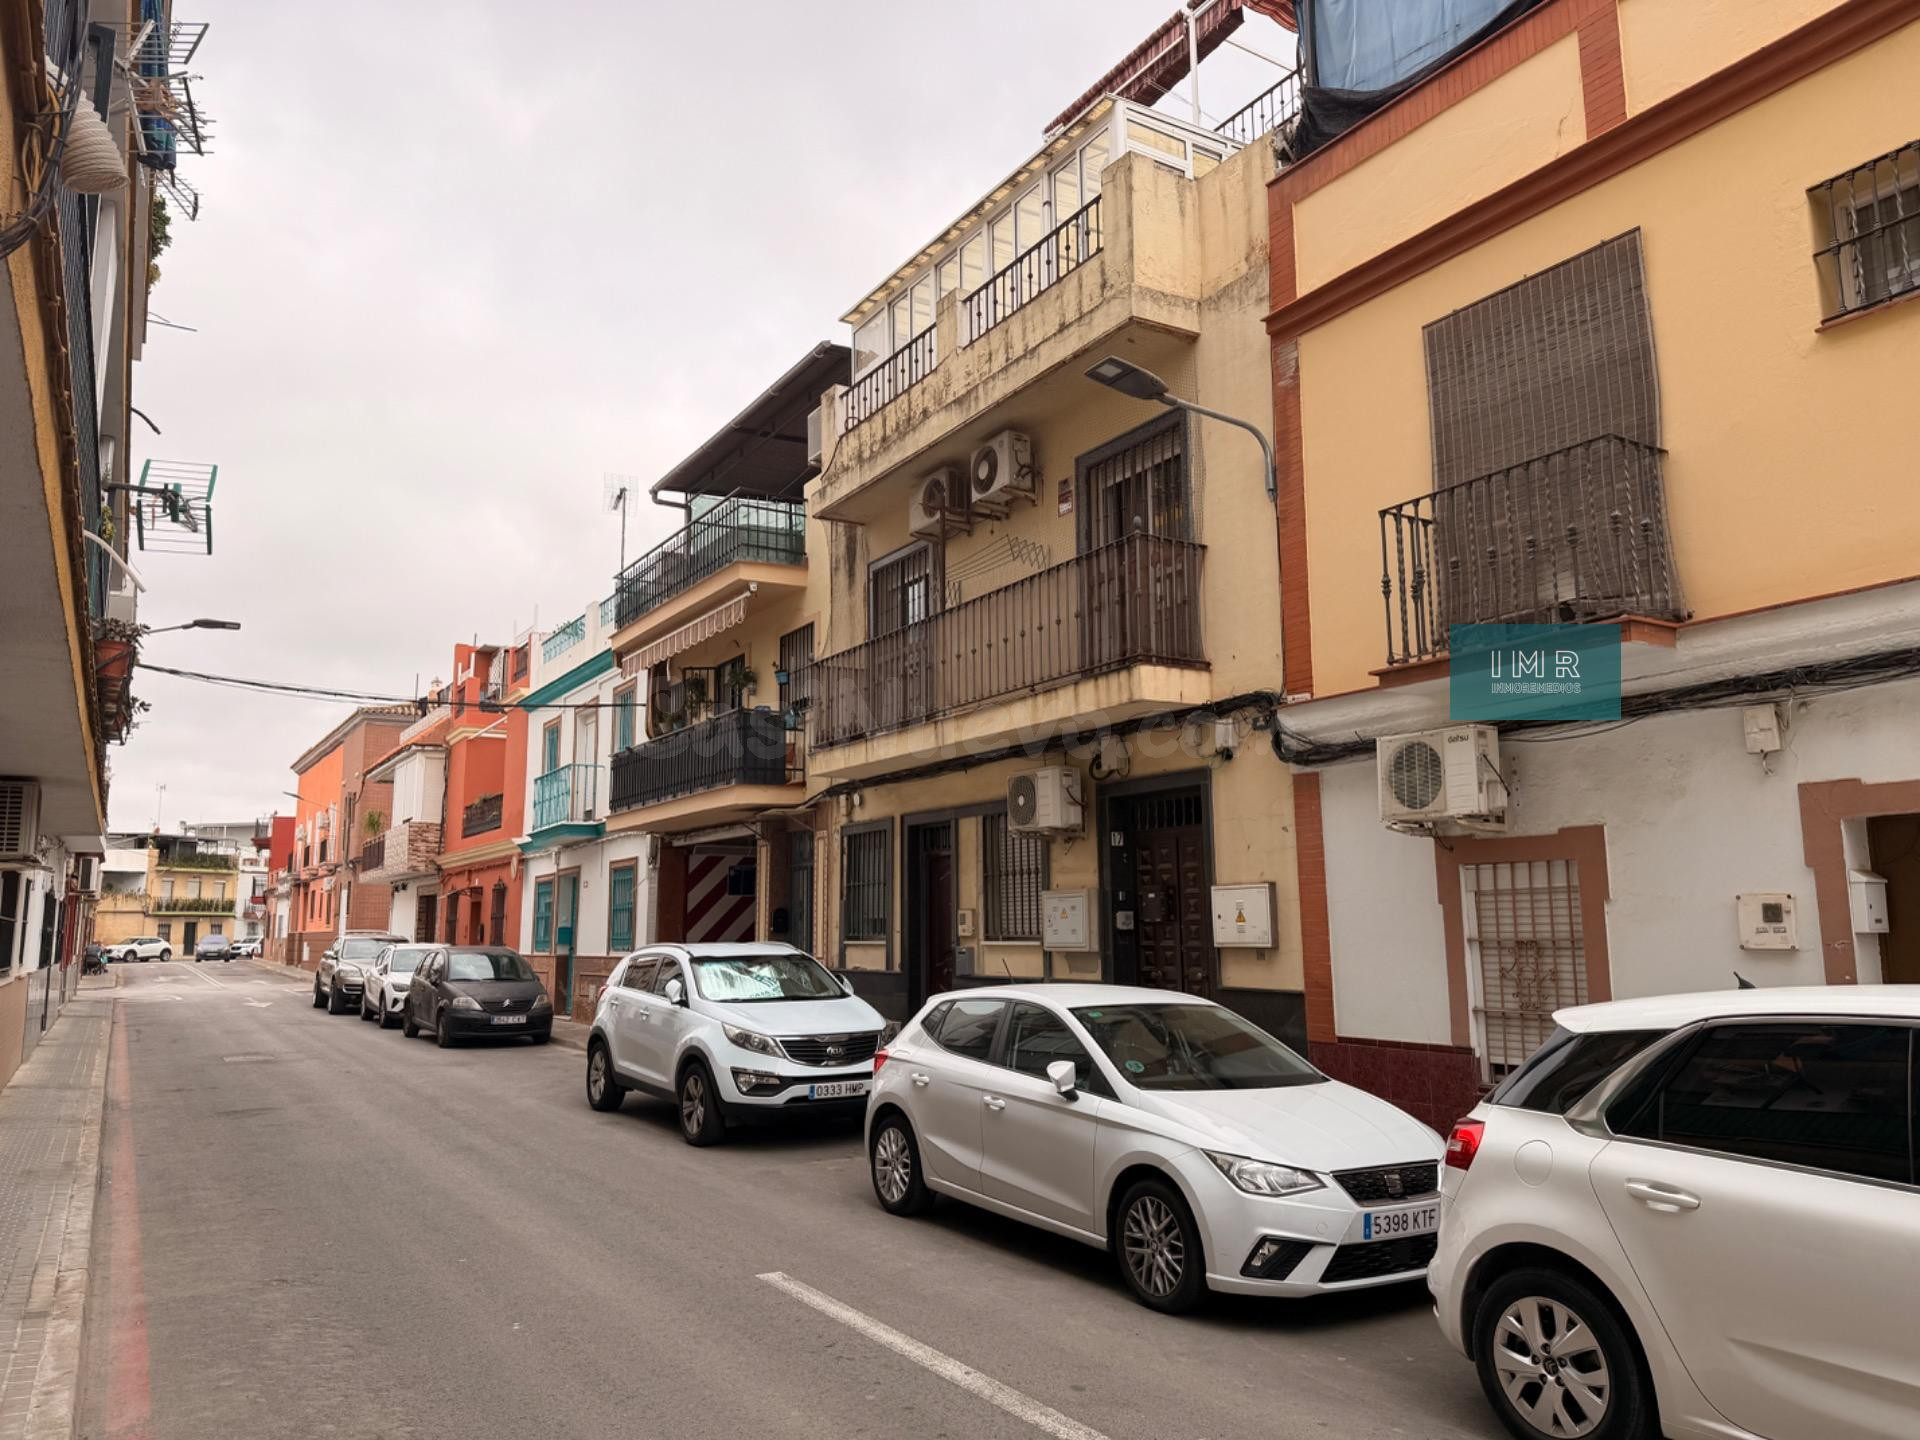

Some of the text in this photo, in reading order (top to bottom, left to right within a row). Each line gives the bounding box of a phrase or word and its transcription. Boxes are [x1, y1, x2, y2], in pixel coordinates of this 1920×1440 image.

[816, 1084, 842, 1097] 0333
[1374, 1208, 1437, 1234] 5398 KTF
